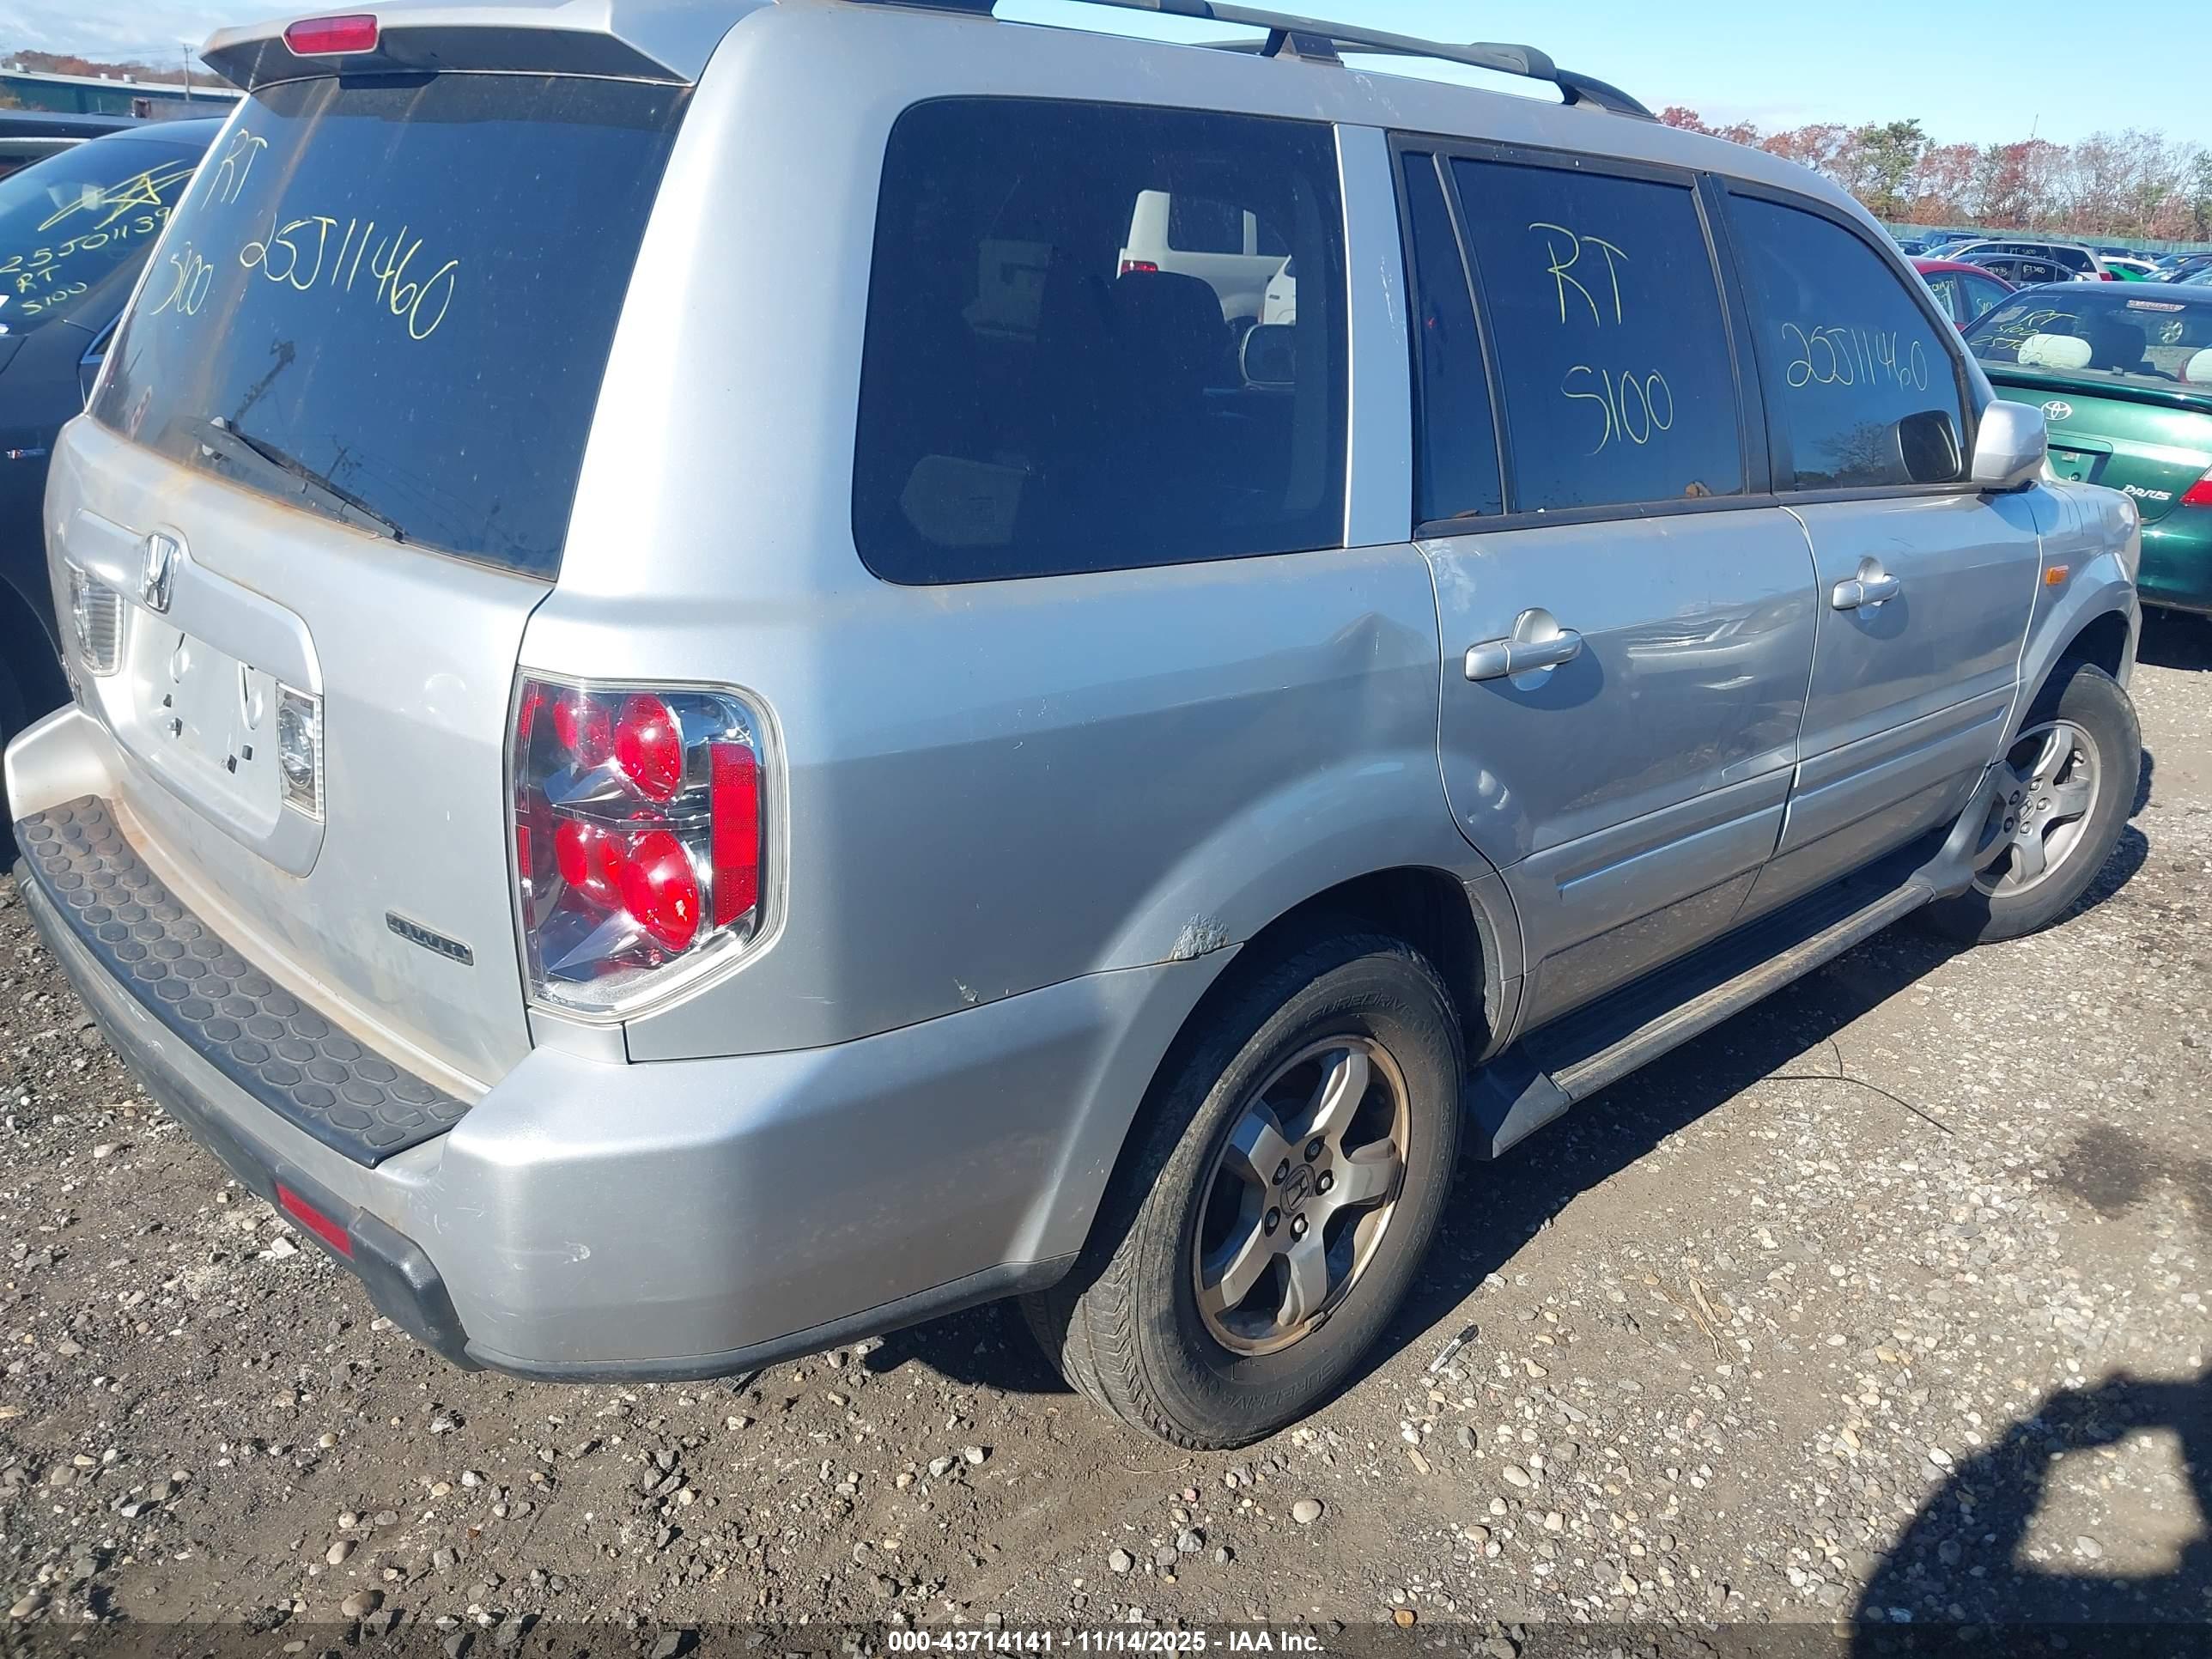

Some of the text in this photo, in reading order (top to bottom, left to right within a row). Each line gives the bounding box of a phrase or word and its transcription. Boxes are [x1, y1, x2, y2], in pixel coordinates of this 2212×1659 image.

[201, 128, 268, 210] RT
[0, 206, 172, 273] 25J01139
[240, 213, 459, 340] 25J11460
[1528, 222, 1629, 328] RT
[16, 264, 62, 294] RT
[21, 282, 88, 316] S100
[1782, 322, 1929, 392] 25J11460
[1560, 365, 1674, 456] S100
